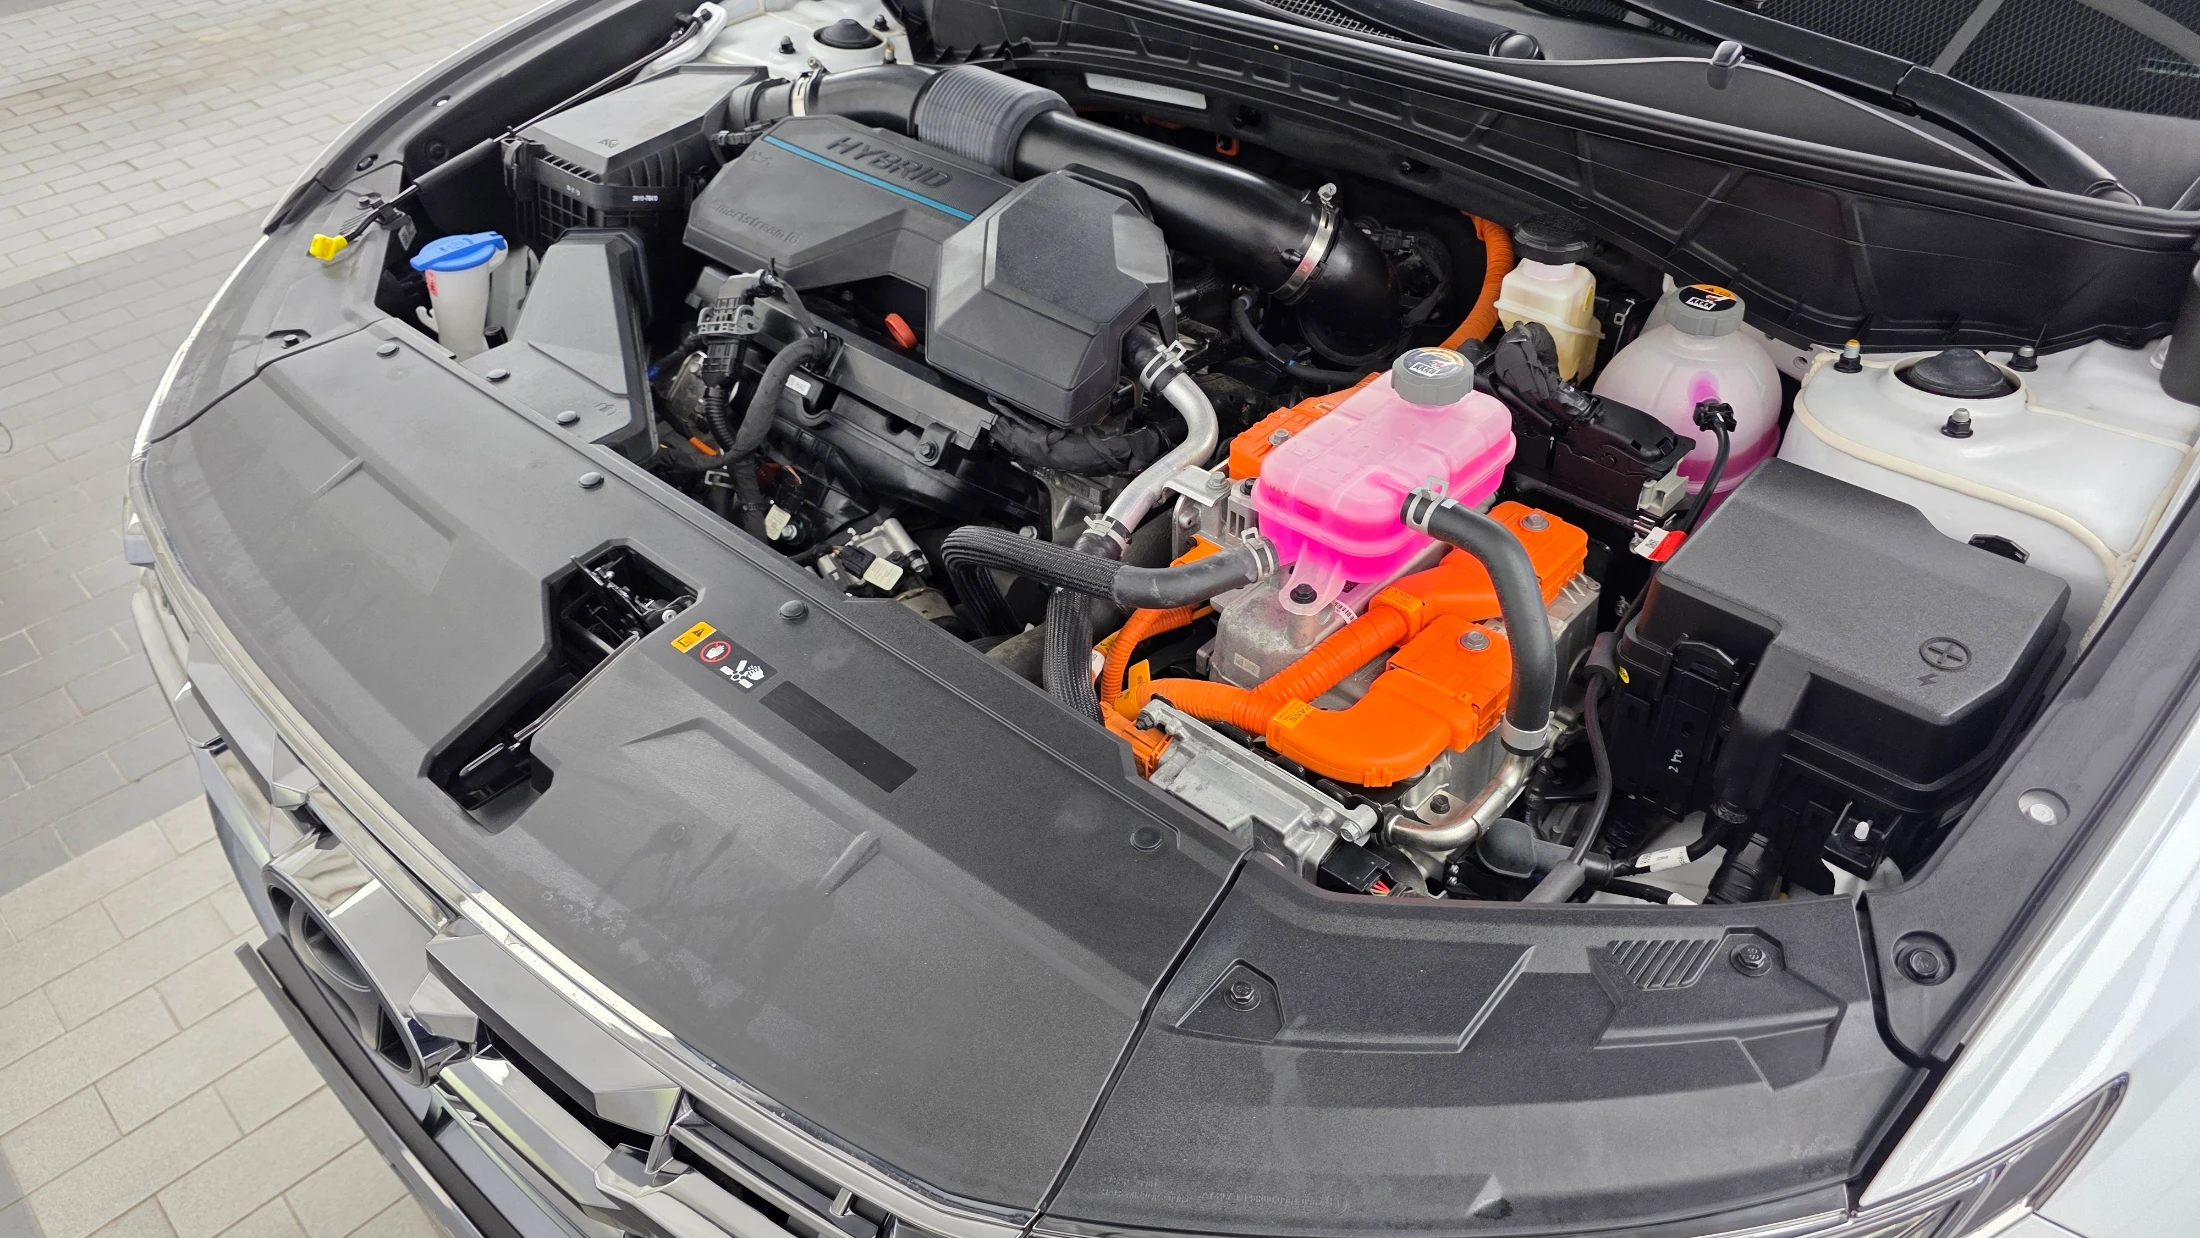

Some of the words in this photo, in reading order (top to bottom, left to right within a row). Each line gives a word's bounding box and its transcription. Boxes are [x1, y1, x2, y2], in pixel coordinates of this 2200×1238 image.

[826, 137, 951, 188] HYBRID
[1269, 484, 1288, 498] MAX
[1268, 495, 1288, 509] MIN
[1290, 704, 1310, 722] PASS
